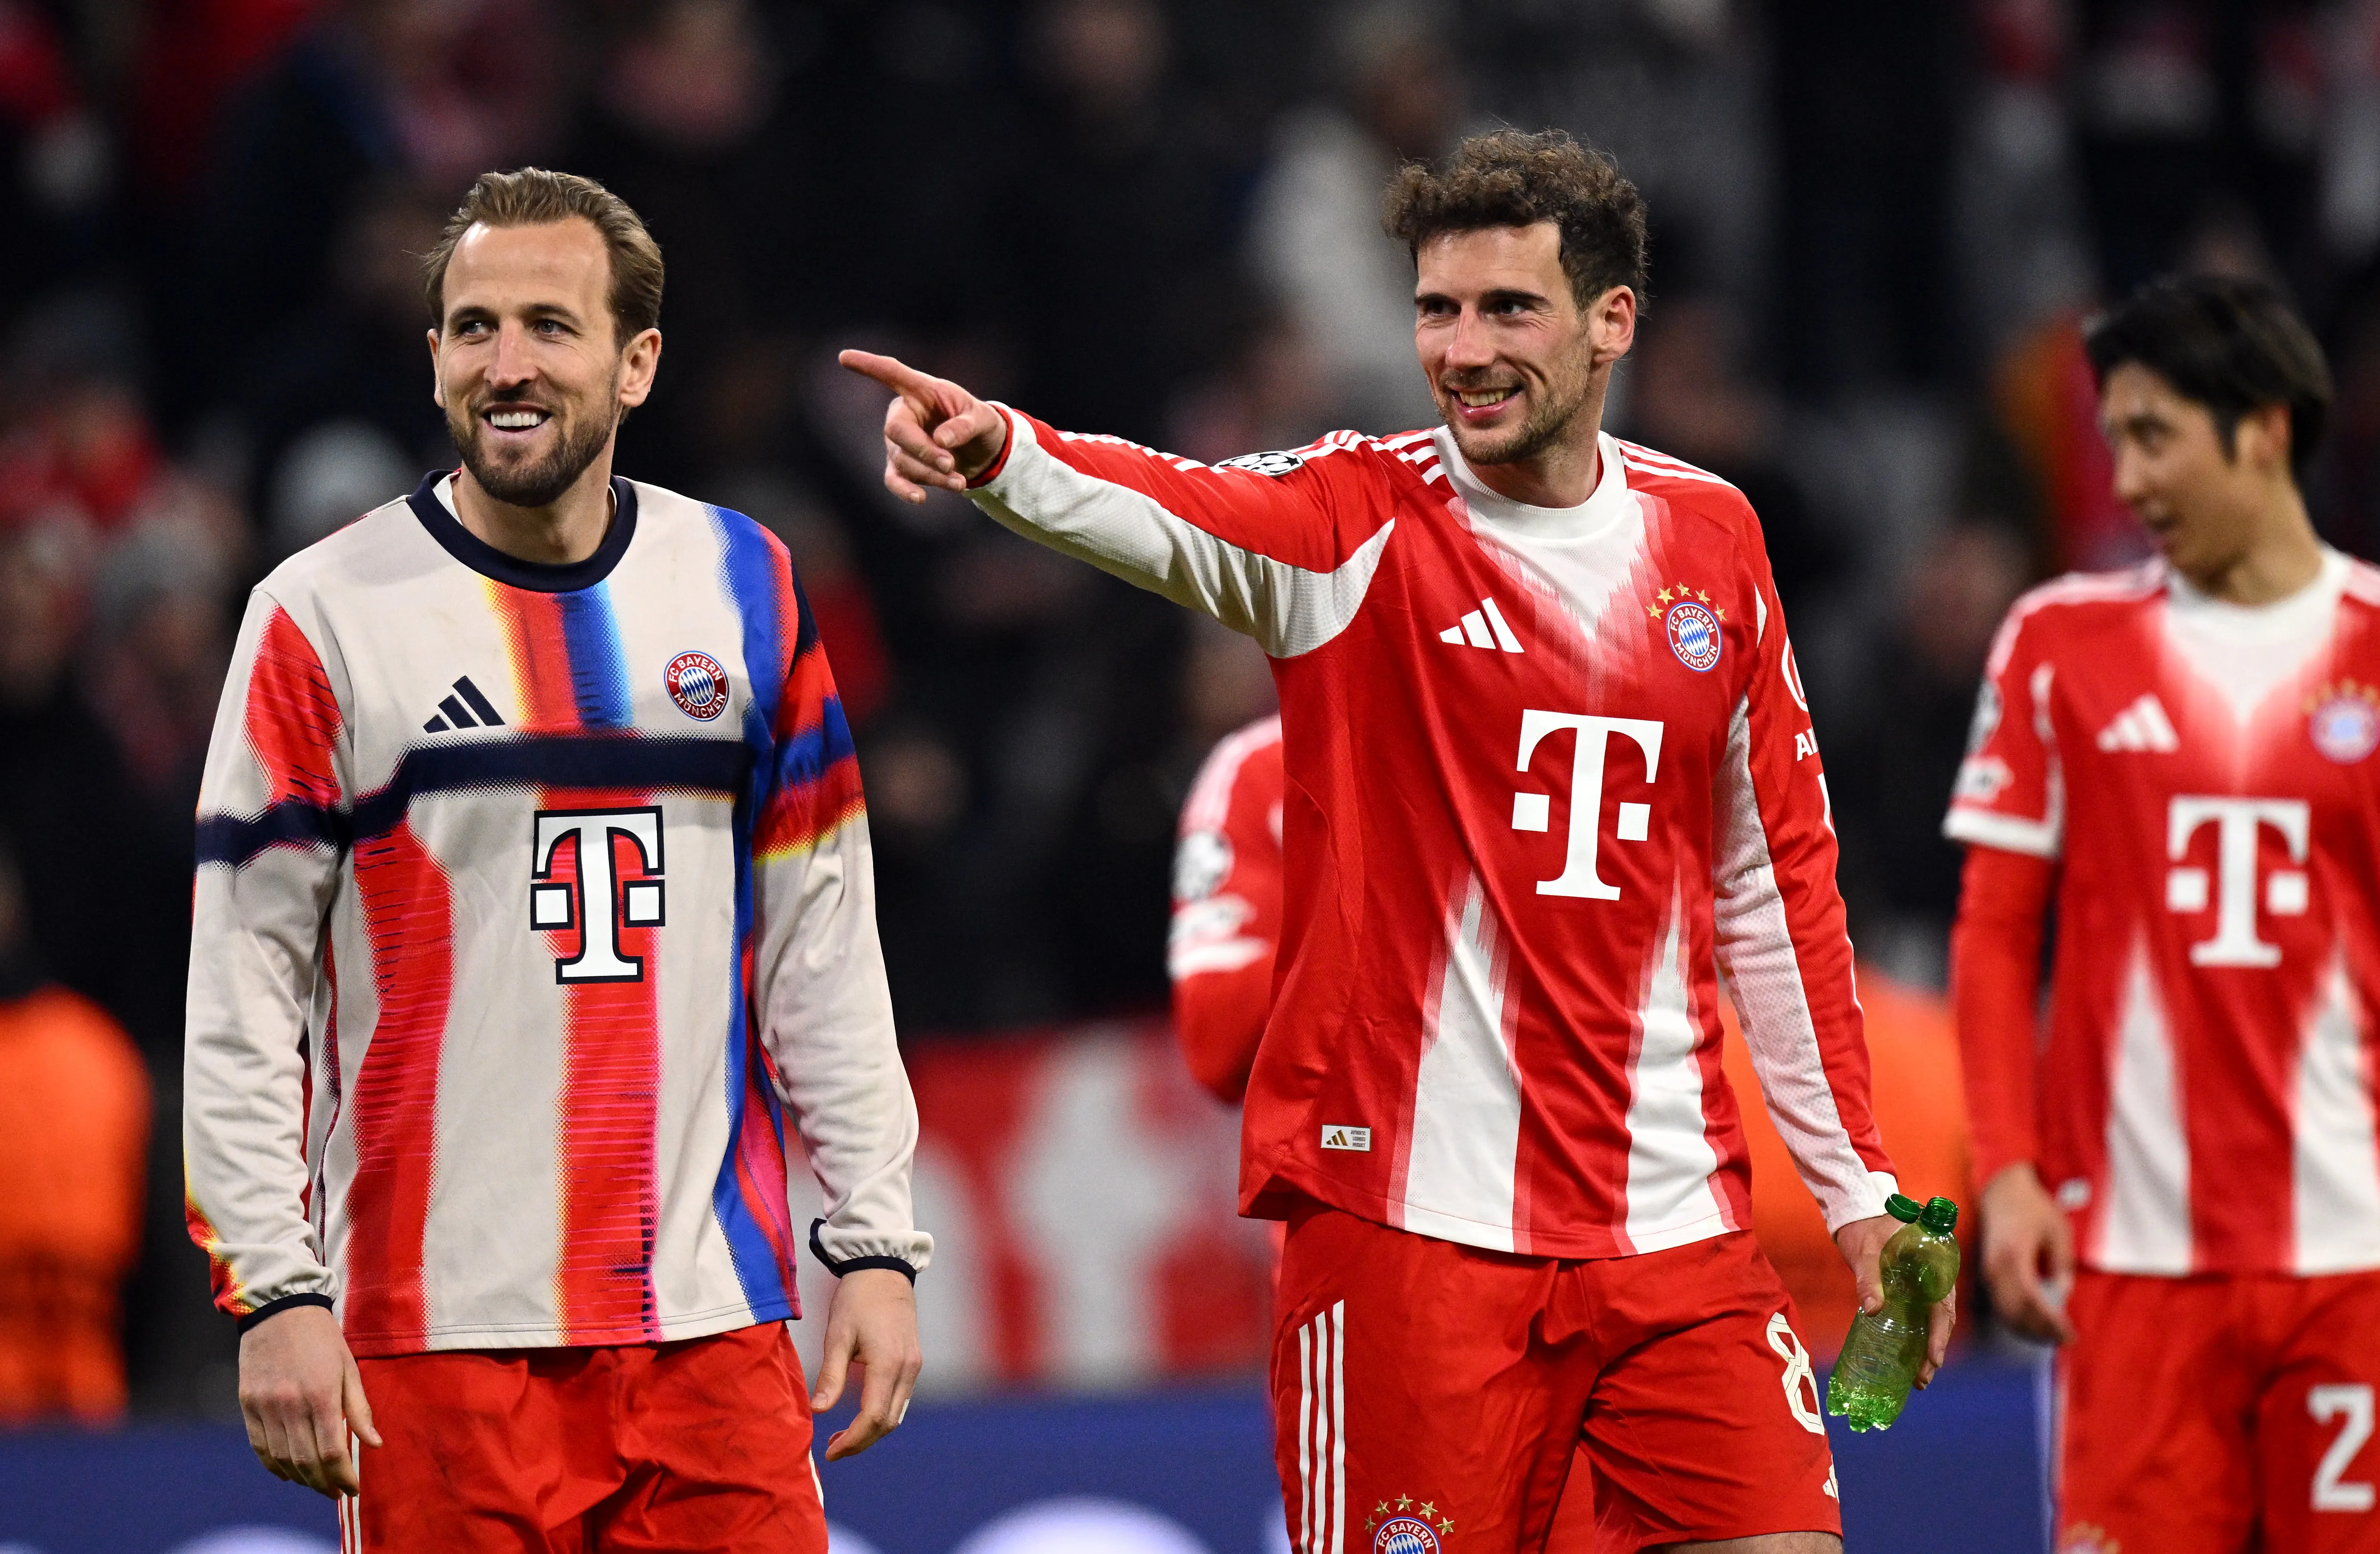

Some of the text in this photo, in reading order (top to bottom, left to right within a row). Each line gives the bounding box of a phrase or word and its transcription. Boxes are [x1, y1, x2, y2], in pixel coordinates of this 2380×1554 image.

[1670, 608, 1715, 633] FC BAYERN
[668, 656, 723, 683] FC BAYERN
[1675, 642, 1717, 667] MÜNCHEN
[674, 692, 725, 717] MÜNCHEN
[1794, 727, 1818, 762] Al
[1512, 709, 1664, 901] T
[530, 805, 666, 985] T
[2166, 794, 2312, 969] T
[1766, 1311, 1825, 1436] 8
[2307, 1382, 2375, 1514] 2
[1378, 1522, 1434, 1549] FC BAYERN
